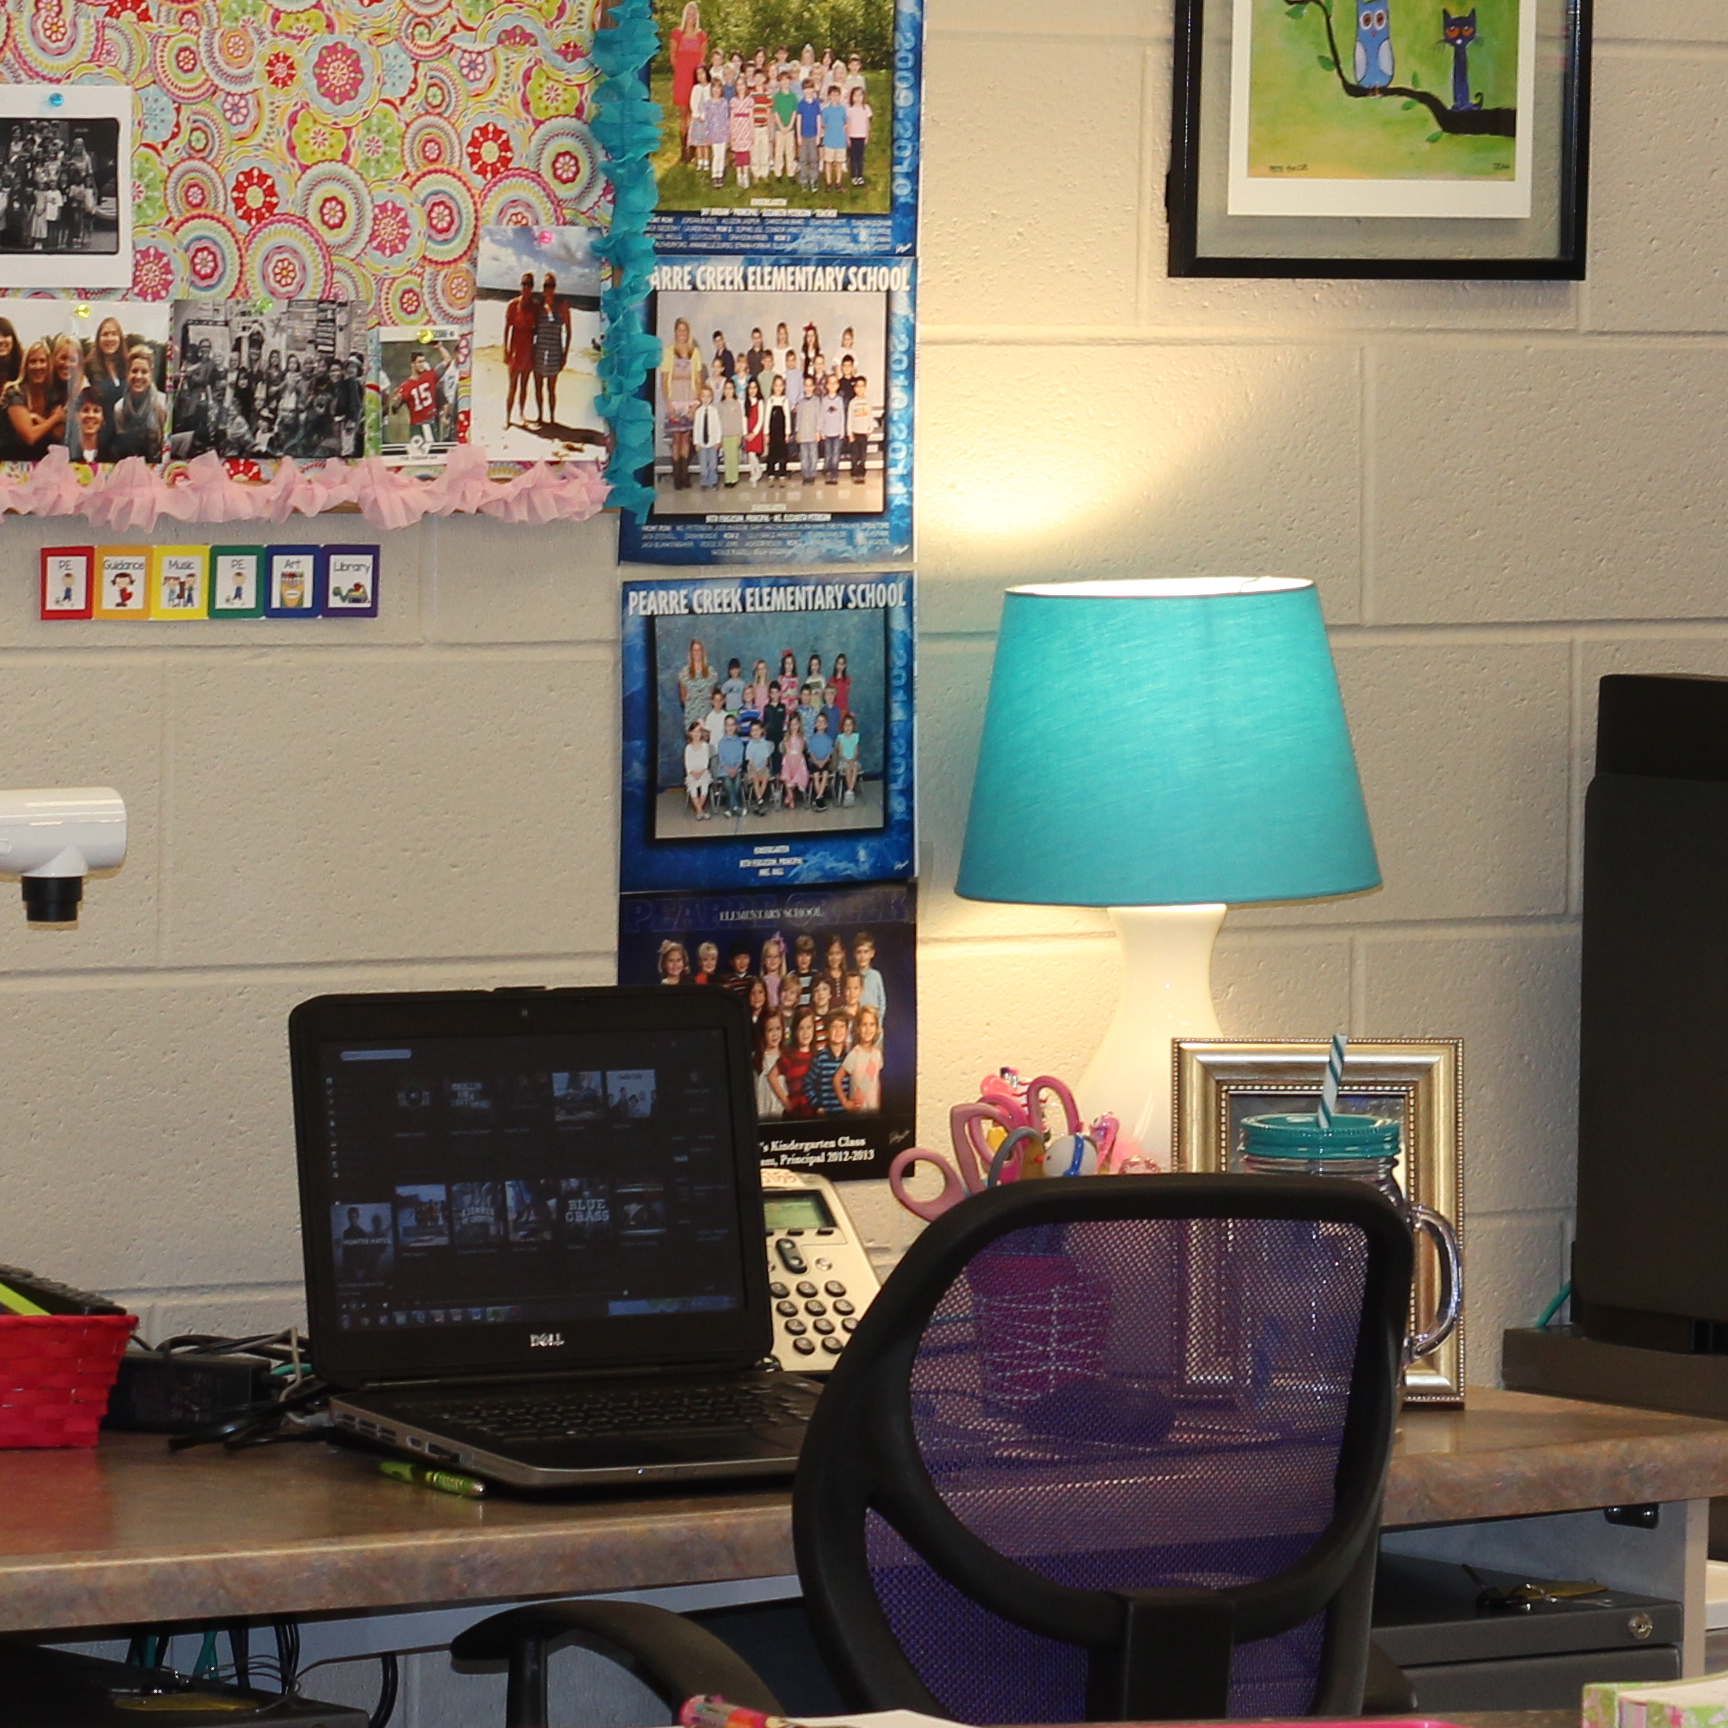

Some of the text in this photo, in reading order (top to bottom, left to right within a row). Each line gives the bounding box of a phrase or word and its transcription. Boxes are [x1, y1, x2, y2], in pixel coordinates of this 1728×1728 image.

[650, 265, 911, 292] ARRE CREEK ELEMENTARY SCHOOL
[410, 382, 434, 412] 15
[103, 558, 146, 572] Guidance
[284, 558, 303, 570] Art
[334, 561, 372, 574] Library
[628, 582, 908, 616] PEARRE CREEK ELEMENTARY SCHOOL
[783, 906, 825, 920] SCHOOL
[770, 1139, 837, 1153] Kindergarten
[838, 1135, 867, 1148] Class
[780, 1152, 826, 1167] Principal
[827, 1148, 876, 1163] 2012-2013
[530, 1332, 565, 1348] DELL
